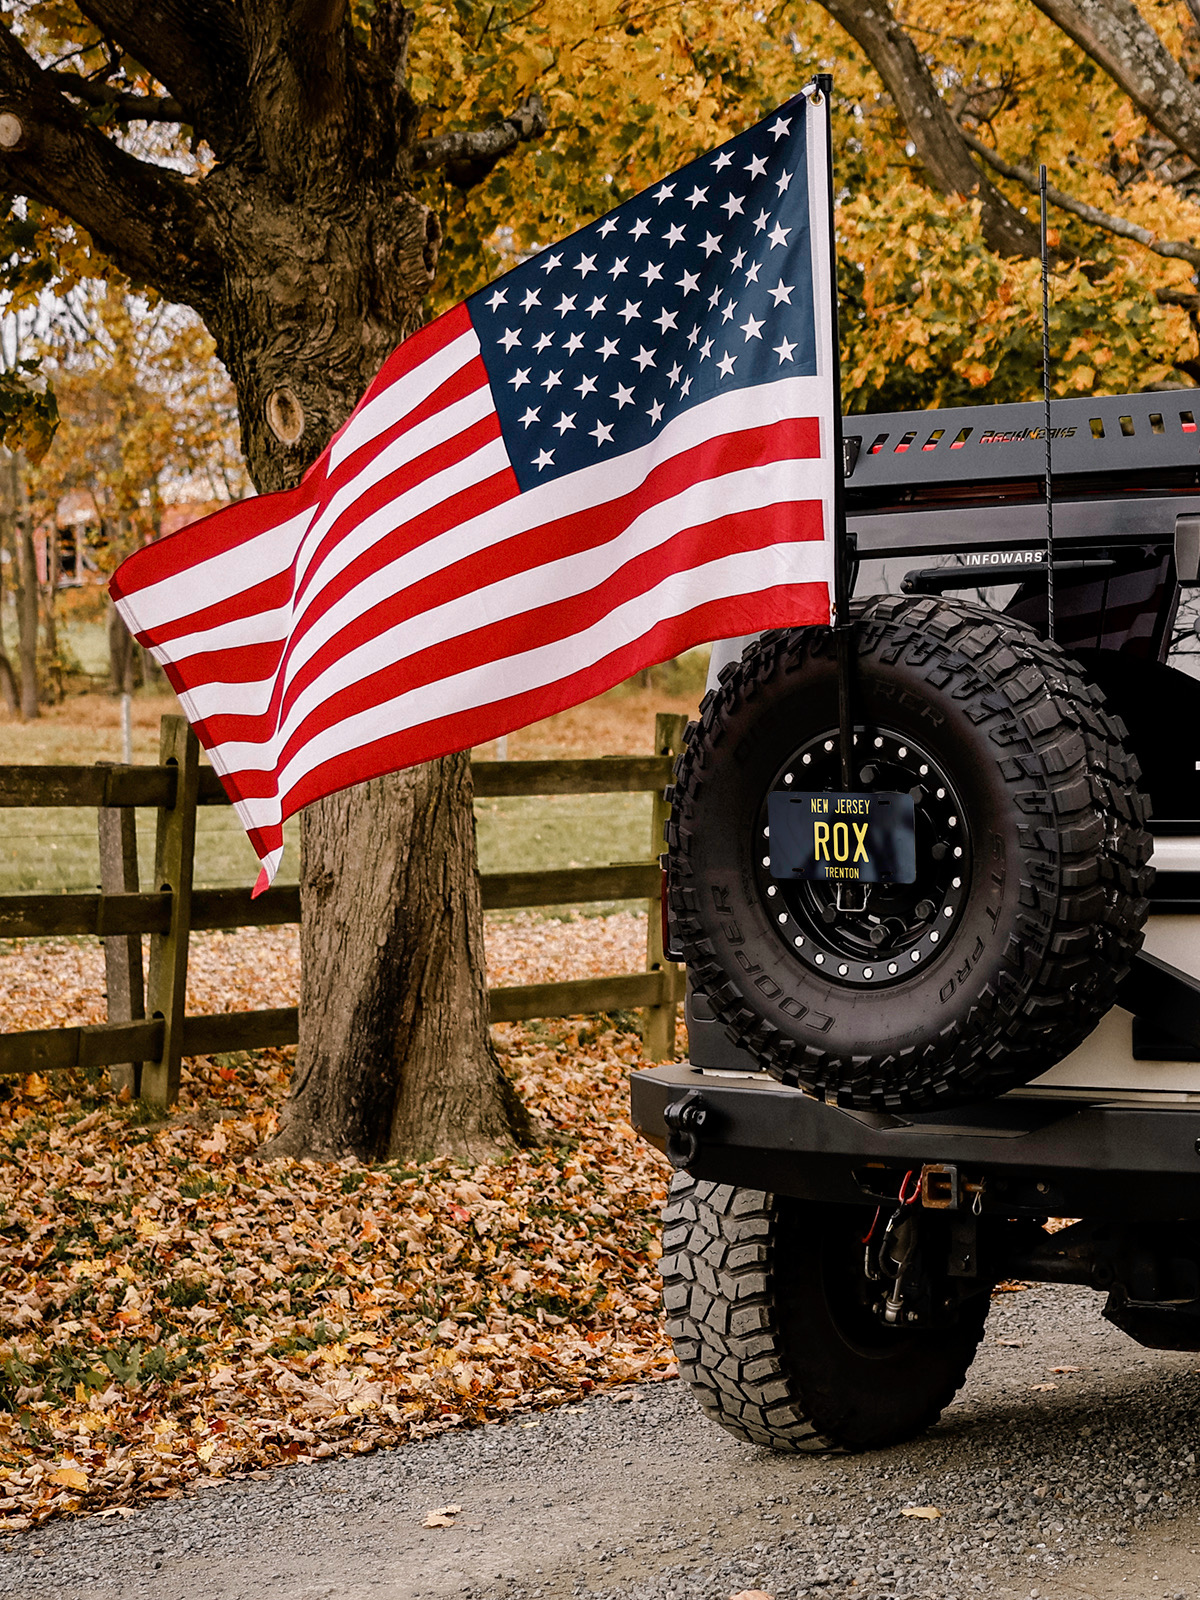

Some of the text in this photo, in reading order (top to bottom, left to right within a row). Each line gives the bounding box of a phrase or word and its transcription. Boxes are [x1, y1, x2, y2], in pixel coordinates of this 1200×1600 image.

[966, 552, 1043, 565] INFOWARS
[811, 798, 870, 814] NEW JERSEY
[814, 821, 869, 863] ROX
[824, 866, 860, 879] TRENTON
